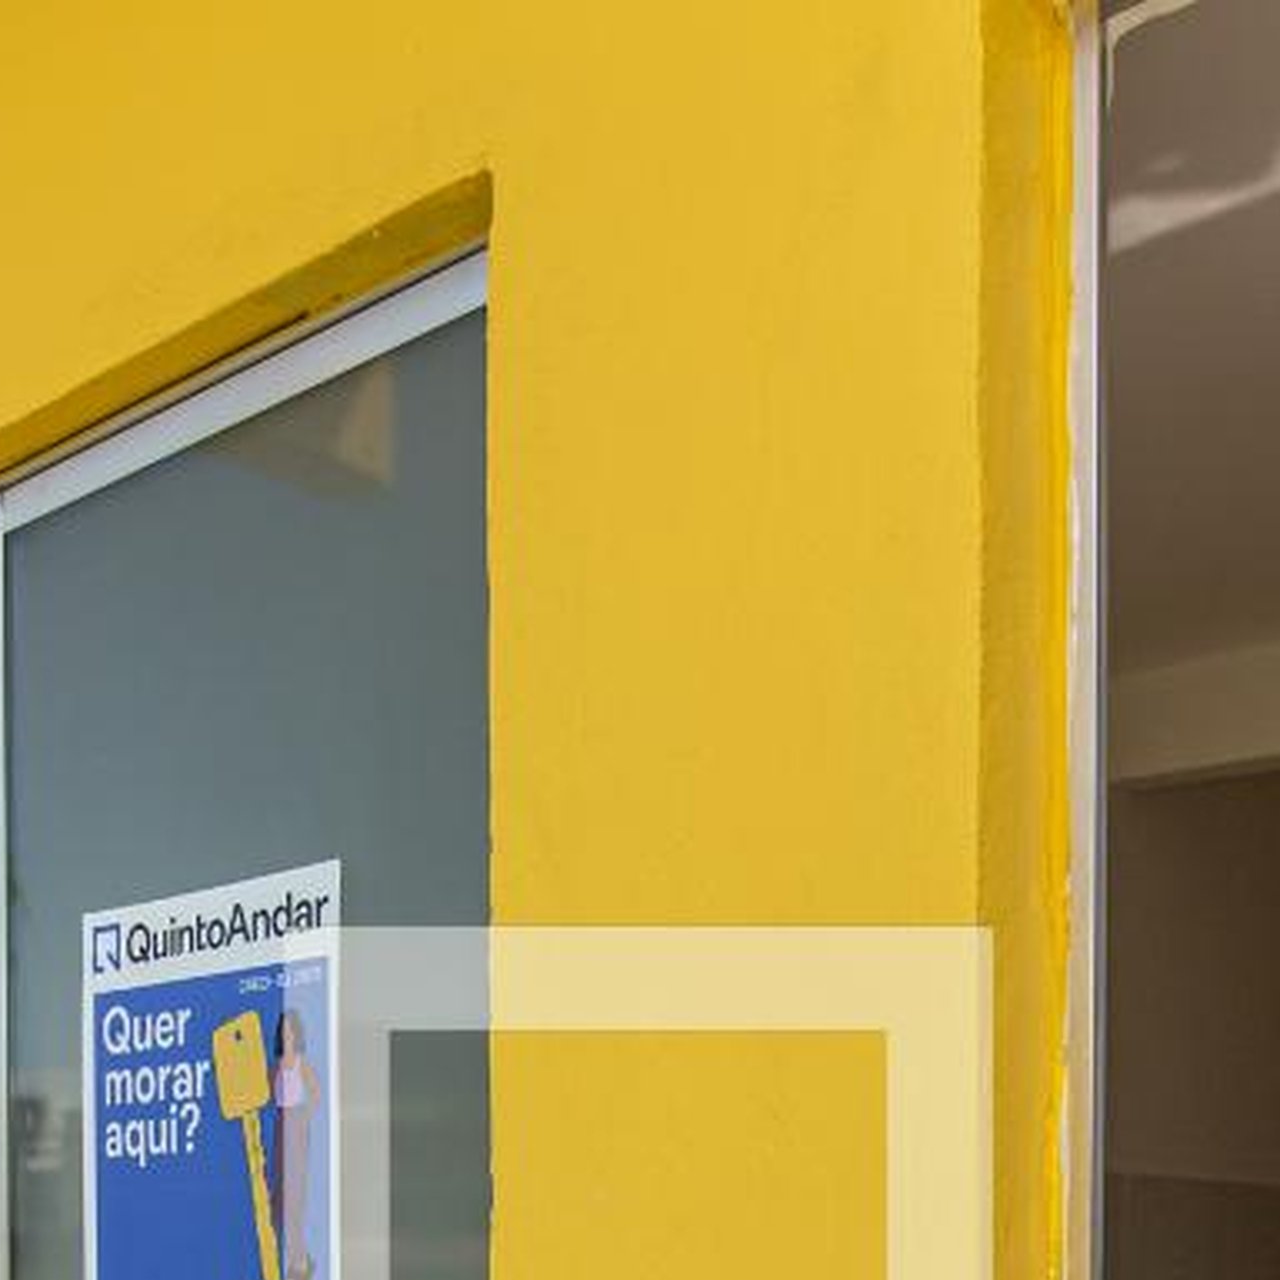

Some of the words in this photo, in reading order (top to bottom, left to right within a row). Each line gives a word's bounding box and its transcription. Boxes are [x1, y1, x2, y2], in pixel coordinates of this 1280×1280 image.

[126, 892, 329, 963] QuintoAndar
[102, 1006, 192, 1054] Quer
[105, 1060, 210, 1106] morar
[105, 1104, 200, 1167] aqui?
